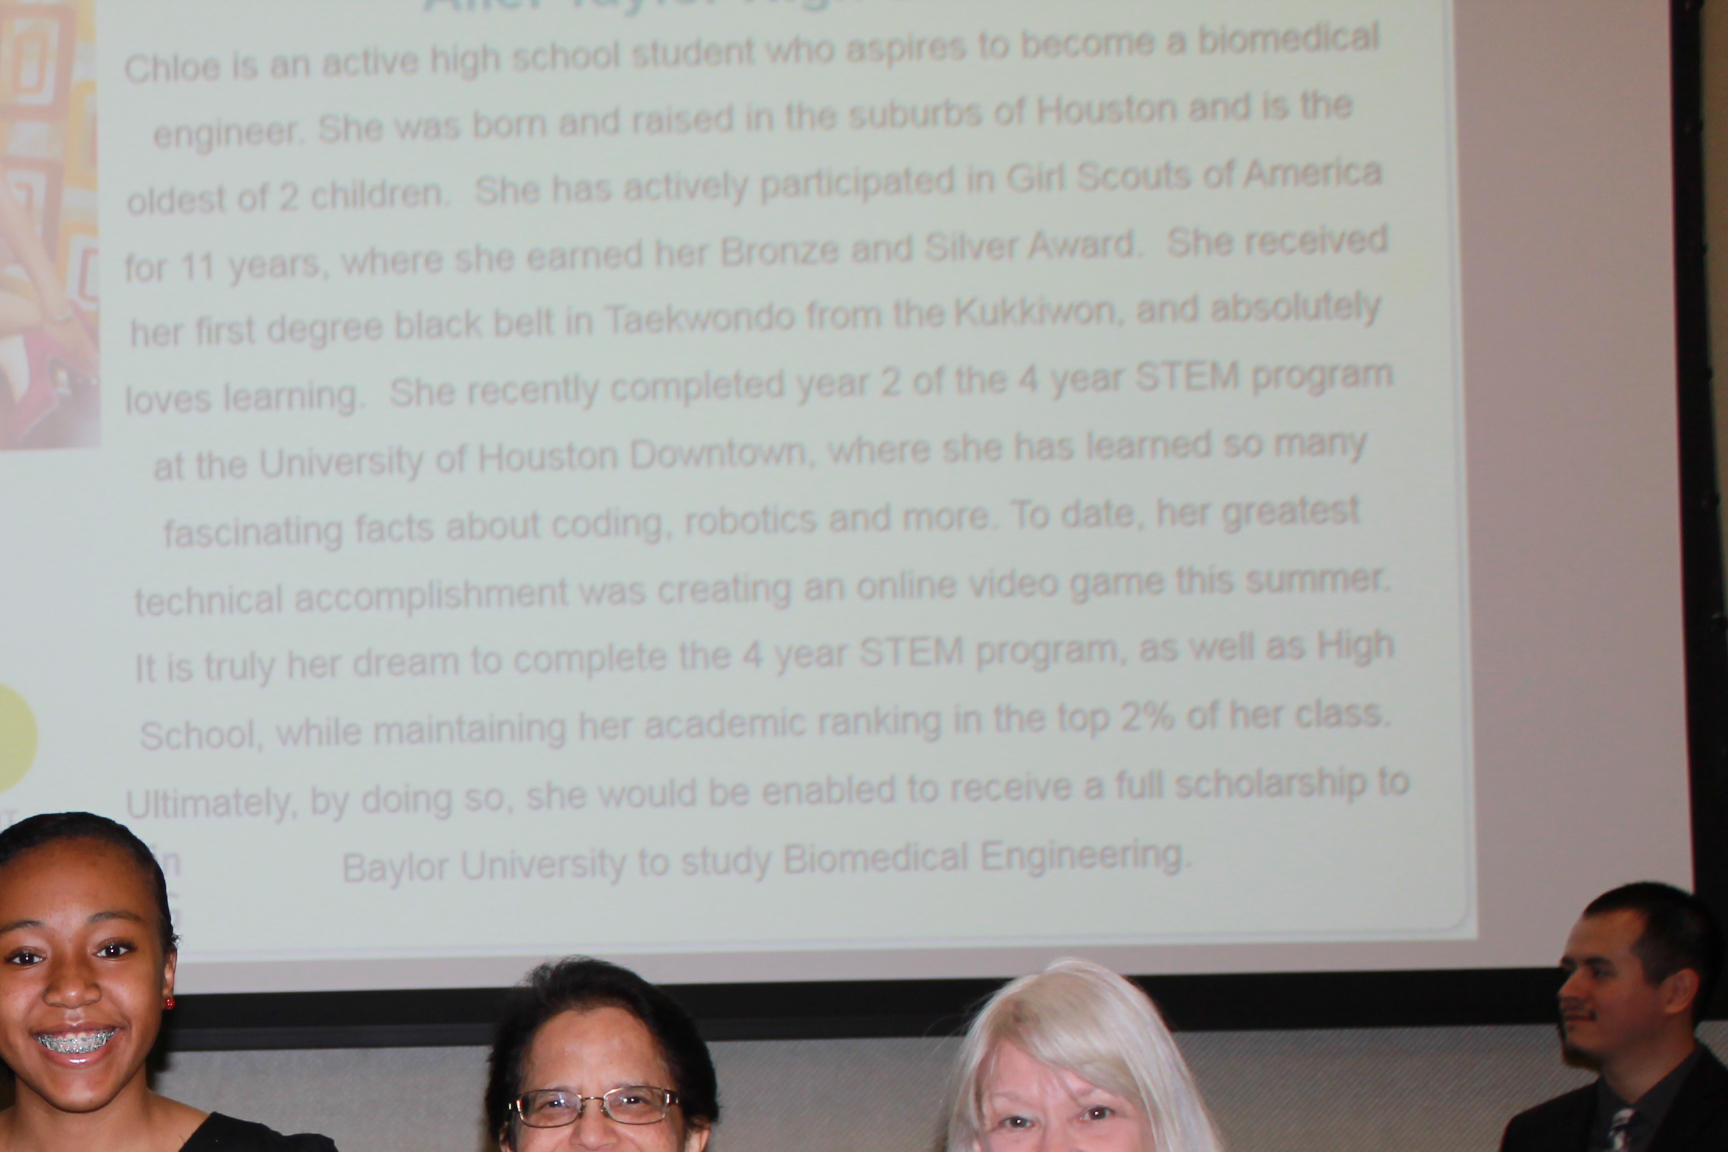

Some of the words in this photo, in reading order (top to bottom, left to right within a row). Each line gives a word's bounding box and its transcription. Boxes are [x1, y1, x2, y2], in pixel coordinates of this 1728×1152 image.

[124, 53, 222, 85] Chloe
[232, 51, 260, 81] is
[270, 54, 312, 80] an
[322, 47, 421, 78] active
[430, 42, 503, 82] high
[511, 40, 624, 73] school
[630, 36, 758, 70] student
[763, 34, 838, 65] who
[844, 33, 969, 72] aspires
[976, 31, 1012, 61] to
[1019, 29, 1158, 60] become
[1164, 32, 1189, 57] a
[1196, 19, 1382, 56] biomedical
[152, 118, 306, 156] engineer.
[318, 113, 386, 145] She
[394, 116, 464, 141] was
[472, 110, 549, 139] born
[558, 105, 624, 137] and
[631, 103, 737, 136] raised
[744, 102, 777, 133] in
[784, 101, 841, 132] the
[847, 98, 985, 131] suburbs
[992, 95, 1028, 128] of
[1035, 94, 1180, 127] Houston
[1186, 92, 1254, 123] and
[1261, 92, 1292, 122] is
[1298, 88, 1355, 121] the
[126, 184, 227, 217] oldest
[237, 181, 271, 213] of
[279, 181, 300, 212] 2
[311, 178, 451, 211] children.
[474, 174, 542, 206] She
[551, 173, 616, 204] has
[622, 169, 751, 209] actively
[759, 165, 959, 207] participated
[965, 162, 998, 194] in
[1004, 161, 1068, 195] Girl
[1076, 160, 1194, 193] Scouts
[1201, 158, 1239, 190] of
[1241, 156, 1385, 190] America
[124, 252, 168, 284] for
[182, 251, 214, 280] 11
[228, 253, 331, 287] years,
[340, 244, 446, 276] where
[454, 241, 516, 274] she
[526, 238, 646, 273] earned
[653, 237, 713, 268] her
[719, 235, 842, 268] Bronze
[850, 233, 917, 265] and
[923, 231, 1021, 264] Silver
[1025, 228, 1145, 260] Award.
[1166, 226, 1237, 260] She
[1243, 223, 1391, 257] received
[130, 319, 185, 348] her
[195, 315, 257, 345] first
[267, 314, 385, 351] degree
[394, 308, 483, 340] black
[493, 307, 556, 338] belt
[565, 305, 596, 336] in
[602, 301, 799, 335] Taekwondo
[804, 299, 886, 331] from
[891, 298, 949, 329] the
[952, 296, 1127, 328] Kukkiwon,
[1134, 292, 1202, 325] and
[1208, 289, 1384, 329] absolutely
[125, 385, 214, 415] loves
[224, 382, 366, 418] learning.
[390, 376, 458, 408] She
[468, 372, 601, 411] recently
[610, 369, 788, 408] completed
[796, 372, 874, 407] year
[880, 365, 904, 398] 2
[911, 364, 949, 397] of
[953, 365, 1011, 396] the
[1016, 363, 1041, 393] 4
[1049, 367, 1129, 402] year
[1135, 359, 1243, 393] STEM
[1250, 362, 1396, 399] program
[163, 516, 345, 553] fascinating
[355, 512, 435, 543] facts
[446, 511, 543, 541] about
[551, 507, 674, 545] coding,
[685, 504, 821, 536] robotics
[827, 502, 894, 533] and
[902, 506, 1001, 532] more.
[1009, 498, 1053, 530] To
[1059, 498, 1147, 531] date,
[1155, 497, 1214, 528] her
[1221, 493, 1363, 536] greatest
[134, 584, 284, 617] technical
[295, 577, 571, 617] accomplishment
[578, 581, 649, 606] was
[657, 573, 795, 611] creating
[803, 576, 849, 603] an
[855, 569, 960, 601] online
[968, 568, 1062, 599] video
[1068, 571, 1168, 606] game
[1174, 565, 1239, 596] this
[1244, 566, 1393, 596] summer.
[136, 654, 157, 683] It
[166, 652, 195, 683] is
[204, 651, 277, 688] truly
[288, 650, 343, 679] her
[353, 647, 462, 677] dream
[471, 646, 505, 675] to
[514, 641, 670, 680] complete
[677, 640, 734, 670] the
[742, 640, 766, 669] 4
[774, 643, 852, 678] year
[859, 635, 967, 667] STEM
[975, 639, 1129, 673] program,
[1138, 637, 1183, 664] as
[1187, 630, 1258, 662] well
[1263, 635, 1309, 662] as
[1316, 628, 1398, 669] High
[140, 718, 264, 752] School,
[276, 717, 363, 746] while
[374, 713, 569, 750] maintaining
[578, 711, 636, 741] her
[644, 709, 808, 740] academic
[817, 706, 945, 744] ranking
[952, 704, 987, 734] in
[992, 703, 1049, 733] the
[1055, 702, 1113, 740] top
[1119, 700, 1178, 732] 2%
[1184, 698, 1224, 731] of
[1228, 699, 1288, 730] her
[1293, 697, 1393, 730] class.
[126, 787, 299, 823] Ultimately,
[311, 787, 351, 823] by
[362, 785, 455, 821] doing
[465, 788, 514, 814] so,
[527, 780, 590, 811] she
[598, 777, 700, 809] would
[708, 777, 752, 807] be
[761, 774, 899, 807] enabled
[906, 773, 942, 804] to
[950, 776, 1075, 803] receive
[1083, 776, 1108, 801] a
[1114, 768, 1167, 801] full
[1173, 765, 1372, 806] scholarship
[1375, 765, 1414, 797] to
